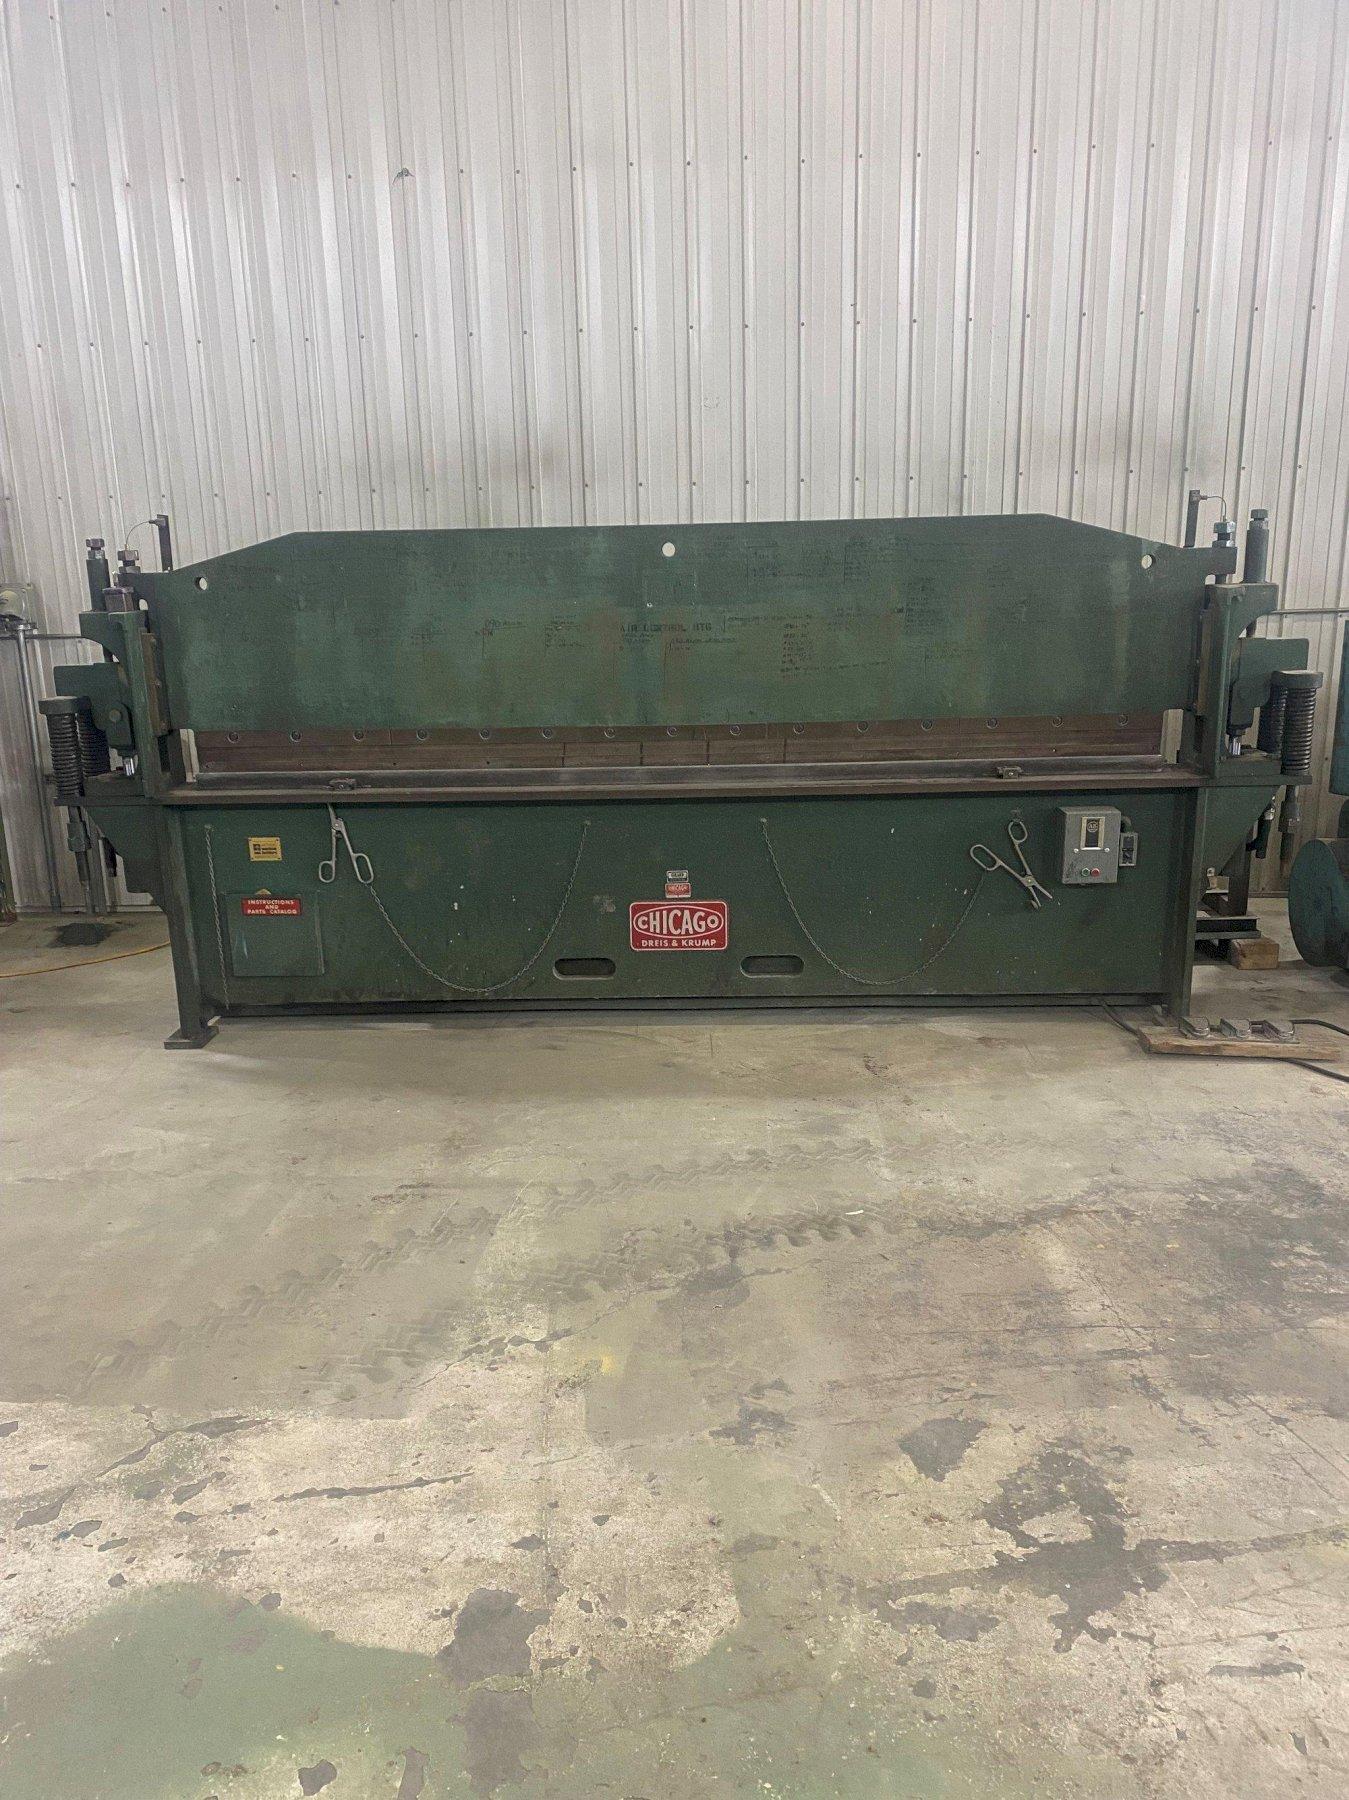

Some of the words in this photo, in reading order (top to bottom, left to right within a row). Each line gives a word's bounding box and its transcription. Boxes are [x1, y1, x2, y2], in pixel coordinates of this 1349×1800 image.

[637, 909, 719, 935] CHICAGO
[641, 939, 668, 947] DREIS
[671, 939, 678, 947] &
[681, 939, 717, 947] KRUMP
